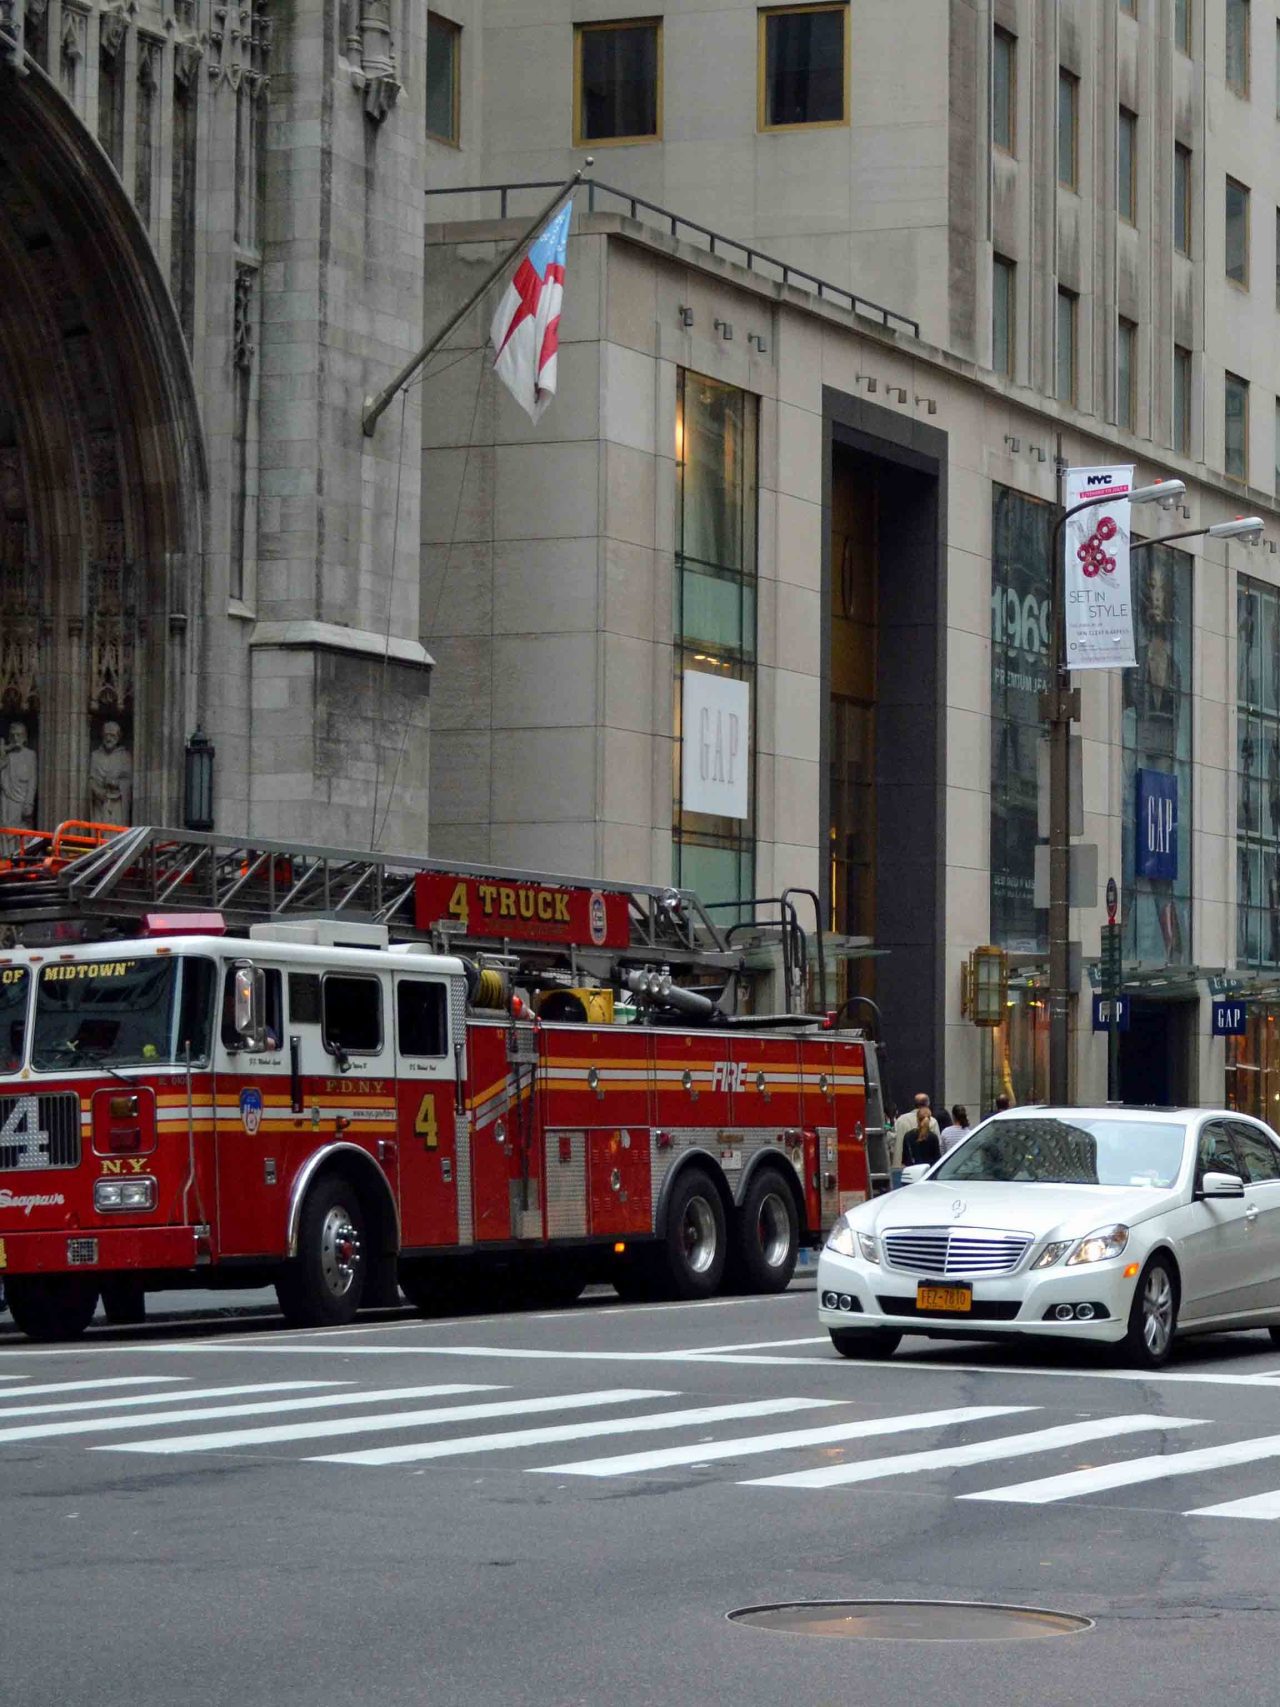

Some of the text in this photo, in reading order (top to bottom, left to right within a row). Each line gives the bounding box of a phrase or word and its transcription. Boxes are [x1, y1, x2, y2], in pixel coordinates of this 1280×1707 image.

[1088, 475, 1112, 485] NYC
[1069, 590, 1106, 603] SET IN
[1089, 604, 1128, 618] STYLE
[701, 706, 739, 784] GAP
[1148, 795, 1172, 853] GAP
[479, 885, 571, 921] TRUCK
[3, 969, 24, 984] OF
[1099, 1001, 1122, 1022] GP
[1218, 1008, 1240, 1028] GAP
[325, 1081, 387, 1093] F.D.N.Y.
[712, 1061, 748, 1092] FIRE
[415, 1093, 438, 1147] 4
[0, 1096, 49, 1168] 4
[101, 1158, 151, 1174] N.Y.
[0, 1189, 65, 1216] Seagrave
